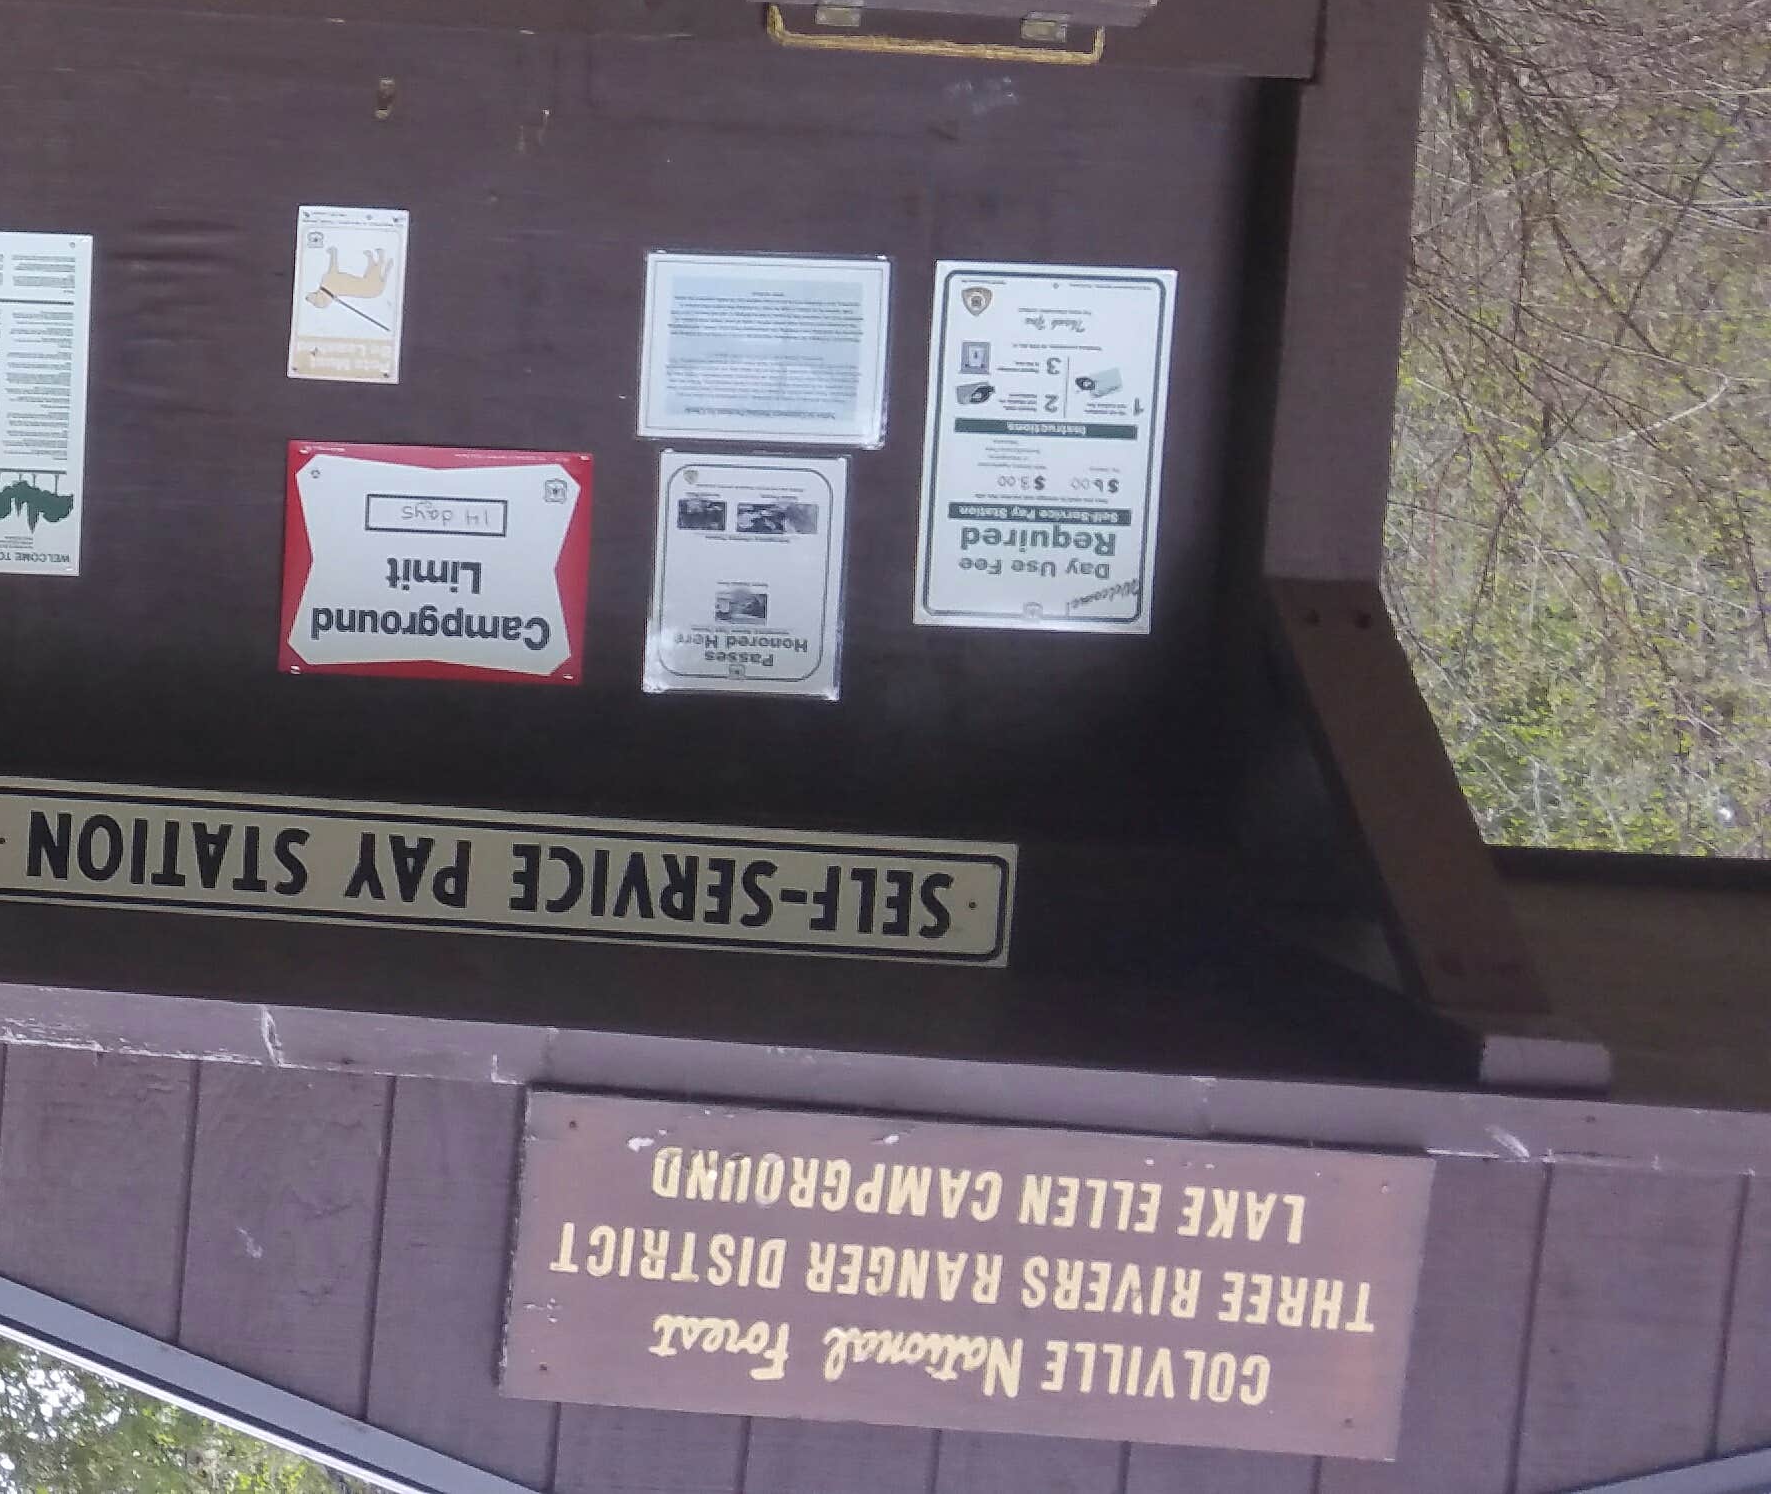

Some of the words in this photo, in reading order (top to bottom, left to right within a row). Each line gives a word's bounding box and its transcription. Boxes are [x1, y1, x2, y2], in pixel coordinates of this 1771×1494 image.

[1046, 356, 1061, 375] 3
[1043, 395, 1059, 413] 2
[1006, 421, 1086, 437] Instructions
[400, 501, 452, 527] days
[466, 509, 488, 527] 14
[15, 552, 70, 563] WELCOME
[960, 524, 1116, 556] Required
[385, 558, 482, 594] Limit
[958, 557, 1002, 575] Fee
[1011, 559, 1056, 578] Use
[1066, 559, 1111, 579] Day
[311, 606, 551, 650] Campground
[672, 632, 719, 650] Here
[725, 634, 808, 652] Honored
[704, 650, 774, 666] Passes
[28, 810, 311, 896] STATION
[345, 833, 472, 909] PAY
[510, 842, 954, 939] SELF-SERVICE
[651, 1146, 1004, 1221] CAMPGROUND
[1021, 1174, 1162, 1234] ELLEN
[1178, 1185, 1306, 1243] LAKE
[549, 1222, 788, 1290] DISTRICT
[808, 1240, 1003, 1304] RANGER
[1022, 1256, 1201, 1319] RIVERS
[1218, 1271, 1374, 1333] THREE
[649, 1314, 789, 1379] Forest
[823, 1325, 1022, 1399] National
[1041, 1339, 1271, 1407] COLVILLE
